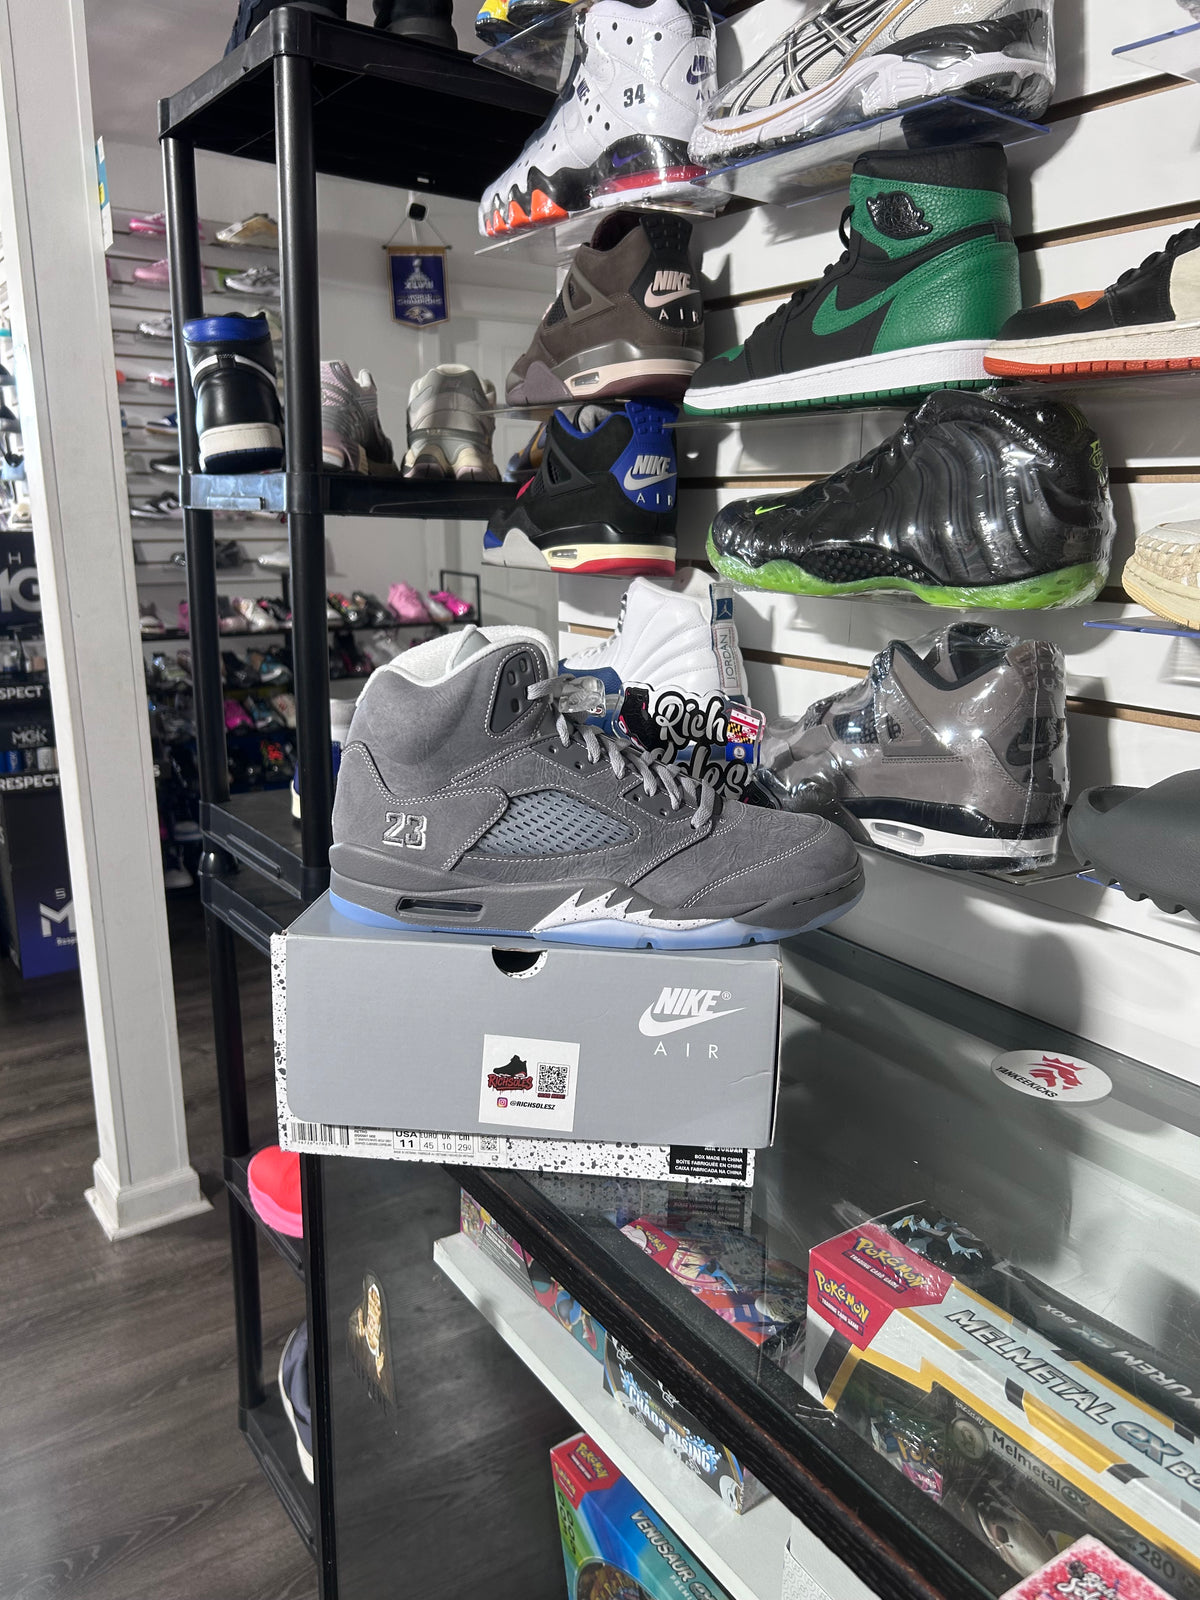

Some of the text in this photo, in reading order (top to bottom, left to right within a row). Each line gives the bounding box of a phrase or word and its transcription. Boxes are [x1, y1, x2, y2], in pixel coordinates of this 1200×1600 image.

[623, 84, 645, 108] 34
[653, 270, 691, 291] NIKE
[659, 308, 699, 323] AIR
[632, 455, 671, 477] NIKE
[636, 492, 673, 507] AIR
[719, 634, 736, 680] JORDAN
[655, 694, 726, 746] Rich
[382, 811, 428, 850] 23
[653, 986, 721, 1016] NIKE
[654, 1041, 718, 1059] AIR
[487, 1073, 533, 1091] RICHSOLES
[996, 1065, 1058, 1098] YANKEEKICKS
[510, 1100, 556, 1110] @RICHSOLESZ
[395, 1130, 418, 1138] USA
[400, 1140, 414, 1149] 11
[423, 1142, 434, 1150] 45
[442, 1143, 452, 1151] 10
[814, 1268, 871, 1324] Pokémon
[1039, 1304, 1078, 1324] BOX
[944, 1309, 1117, 1426] MELMETAL
[1111, 1420, 1184, 1467] ex
[628, 1385, 666, 1434] CHAOS
[668, 1427, 711, 1474] RISING
[992, 1430, 1061, 1492] Melmetal
[630, 1508, 697, 1583] VENUSAUR
[1136, 1541, 1176, 1580] 280
